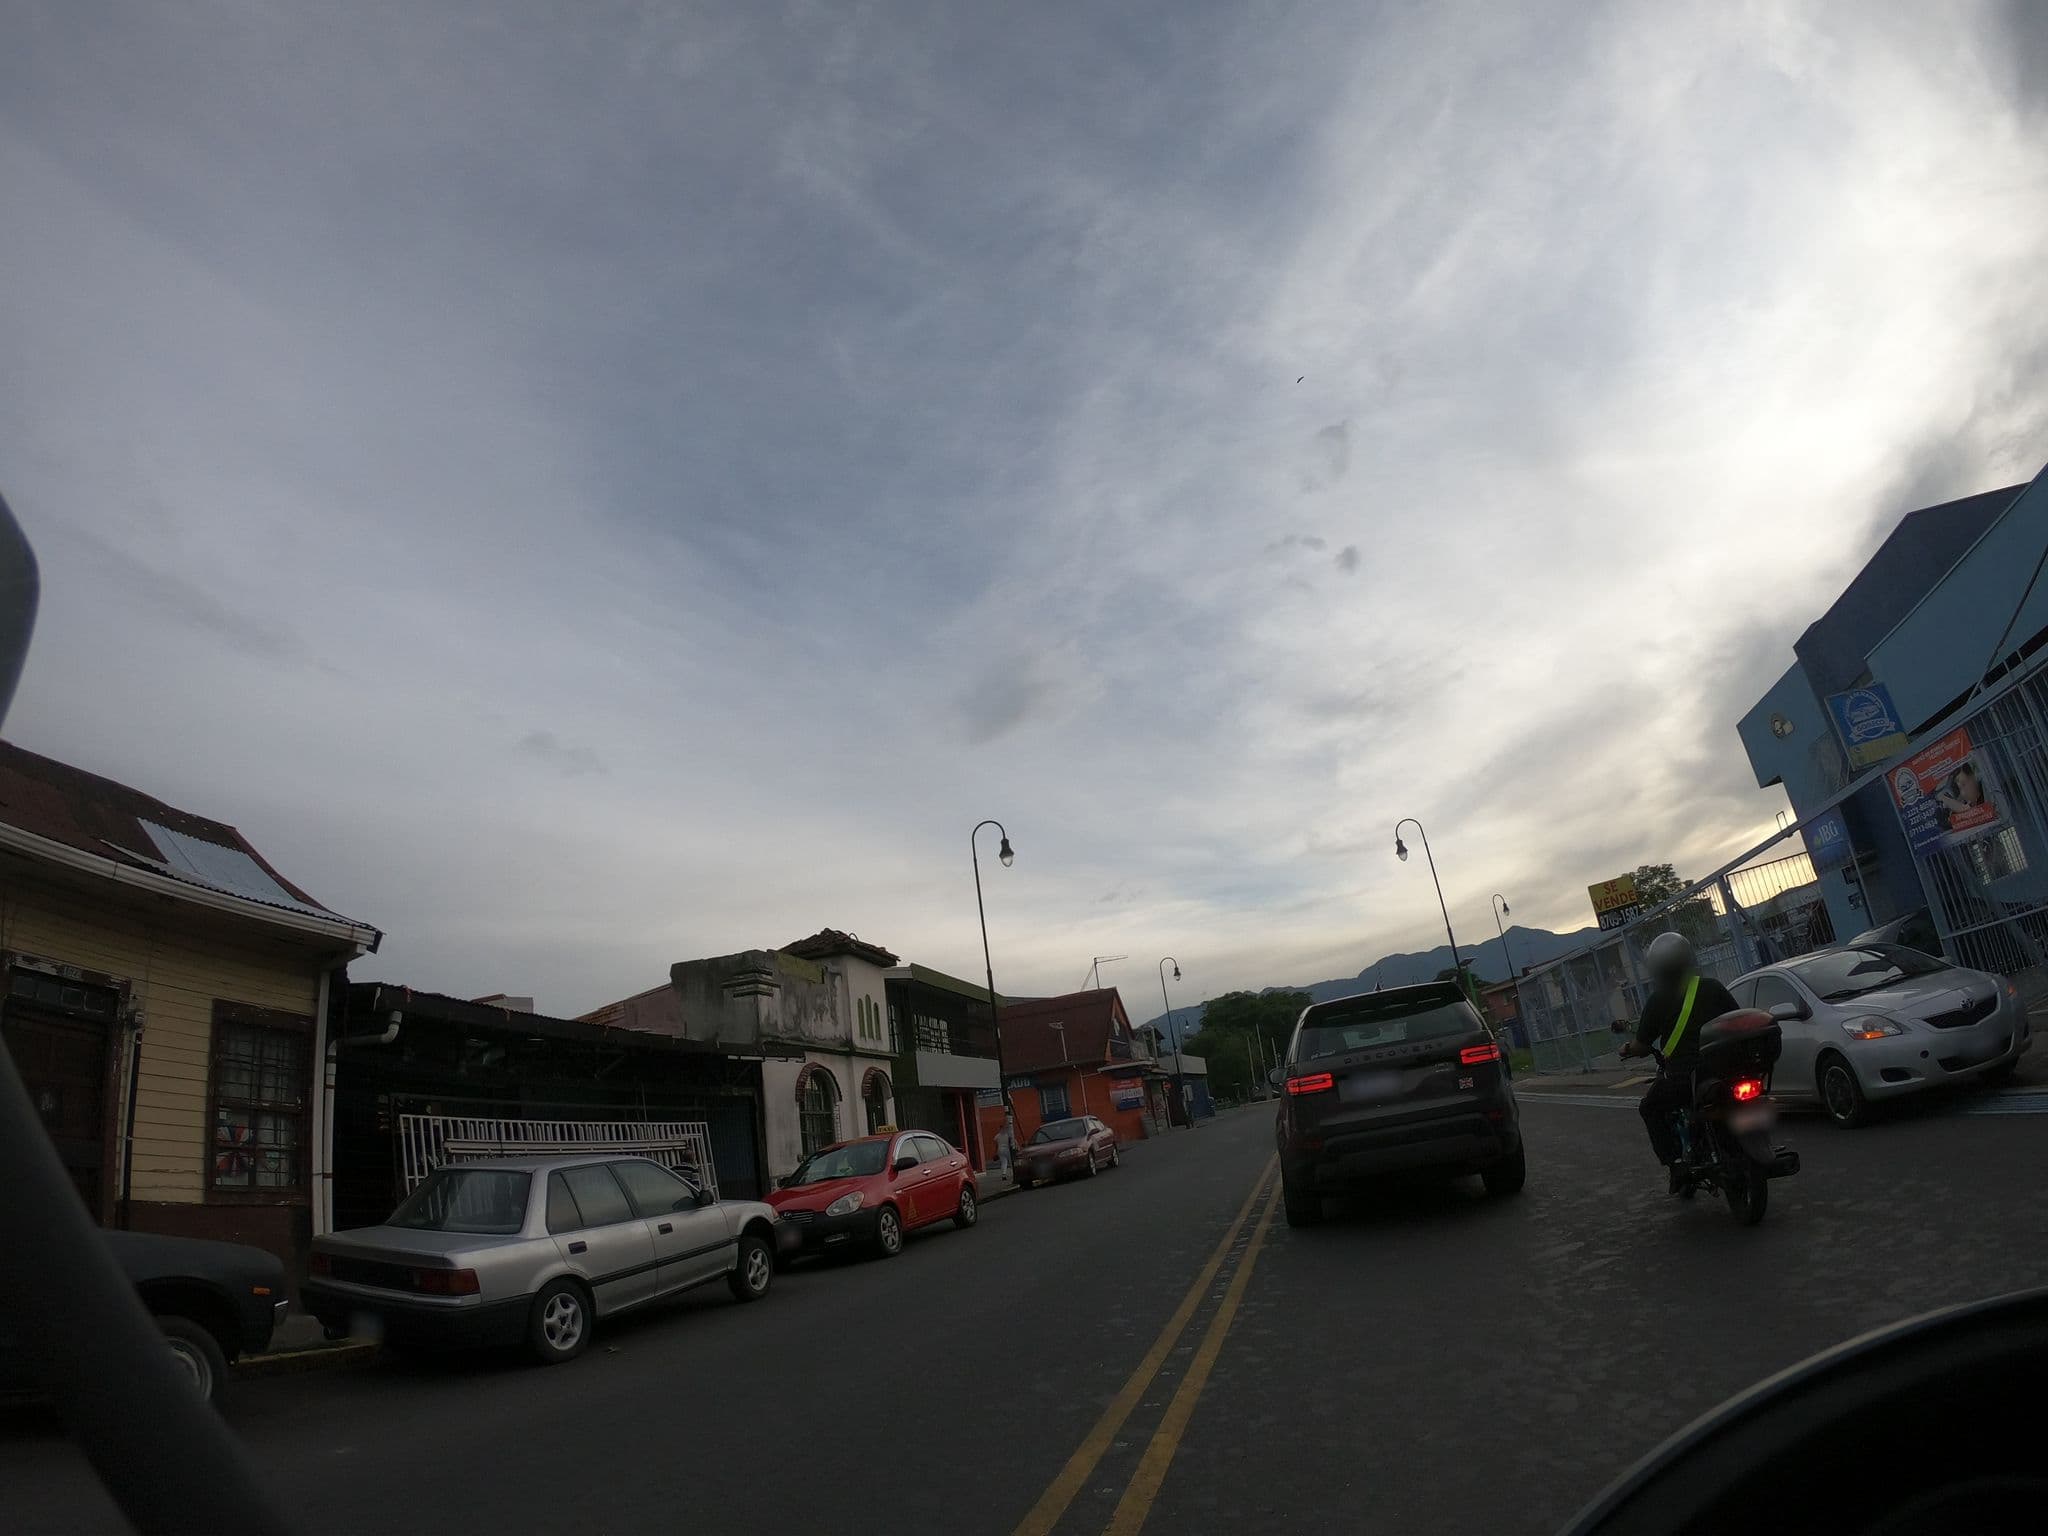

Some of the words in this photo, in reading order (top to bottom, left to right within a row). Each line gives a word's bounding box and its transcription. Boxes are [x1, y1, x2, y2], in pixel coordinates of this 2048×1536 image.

[1604, 880, 1618, 894] SE
[1594, 889, 1636, 910] VENDE
[1344, 1042, 1443, 1064] DISCOVERY
